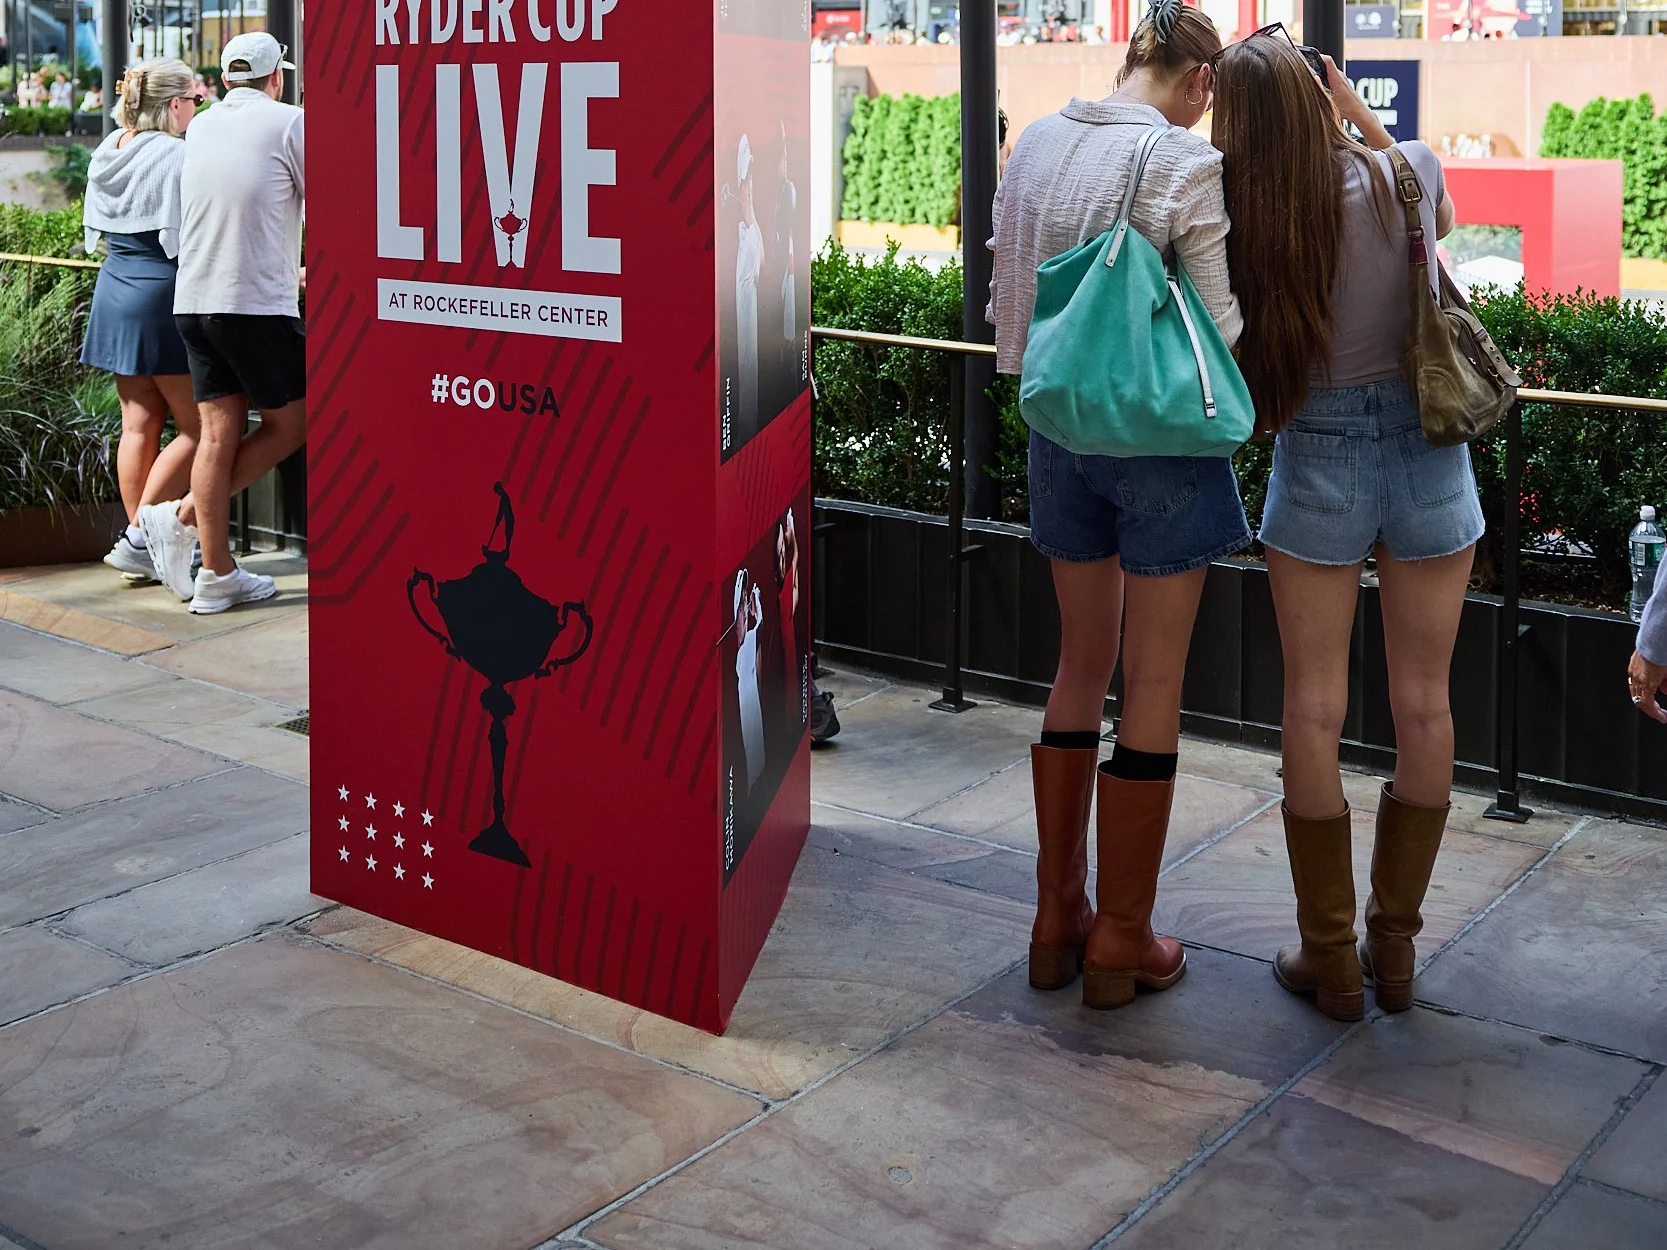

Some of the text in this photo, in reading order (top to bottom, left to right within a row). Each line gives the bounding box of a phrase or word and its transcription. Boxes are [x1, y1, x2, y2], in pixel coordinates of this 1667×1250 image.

[1355, 77, 1399, 108] CUP
[375, 61, 622, 275] LIVE
[389, 292, 609, 328] AT ROCKEFELLER CENTER
[431, 373, 561, 419] #GOUSA
